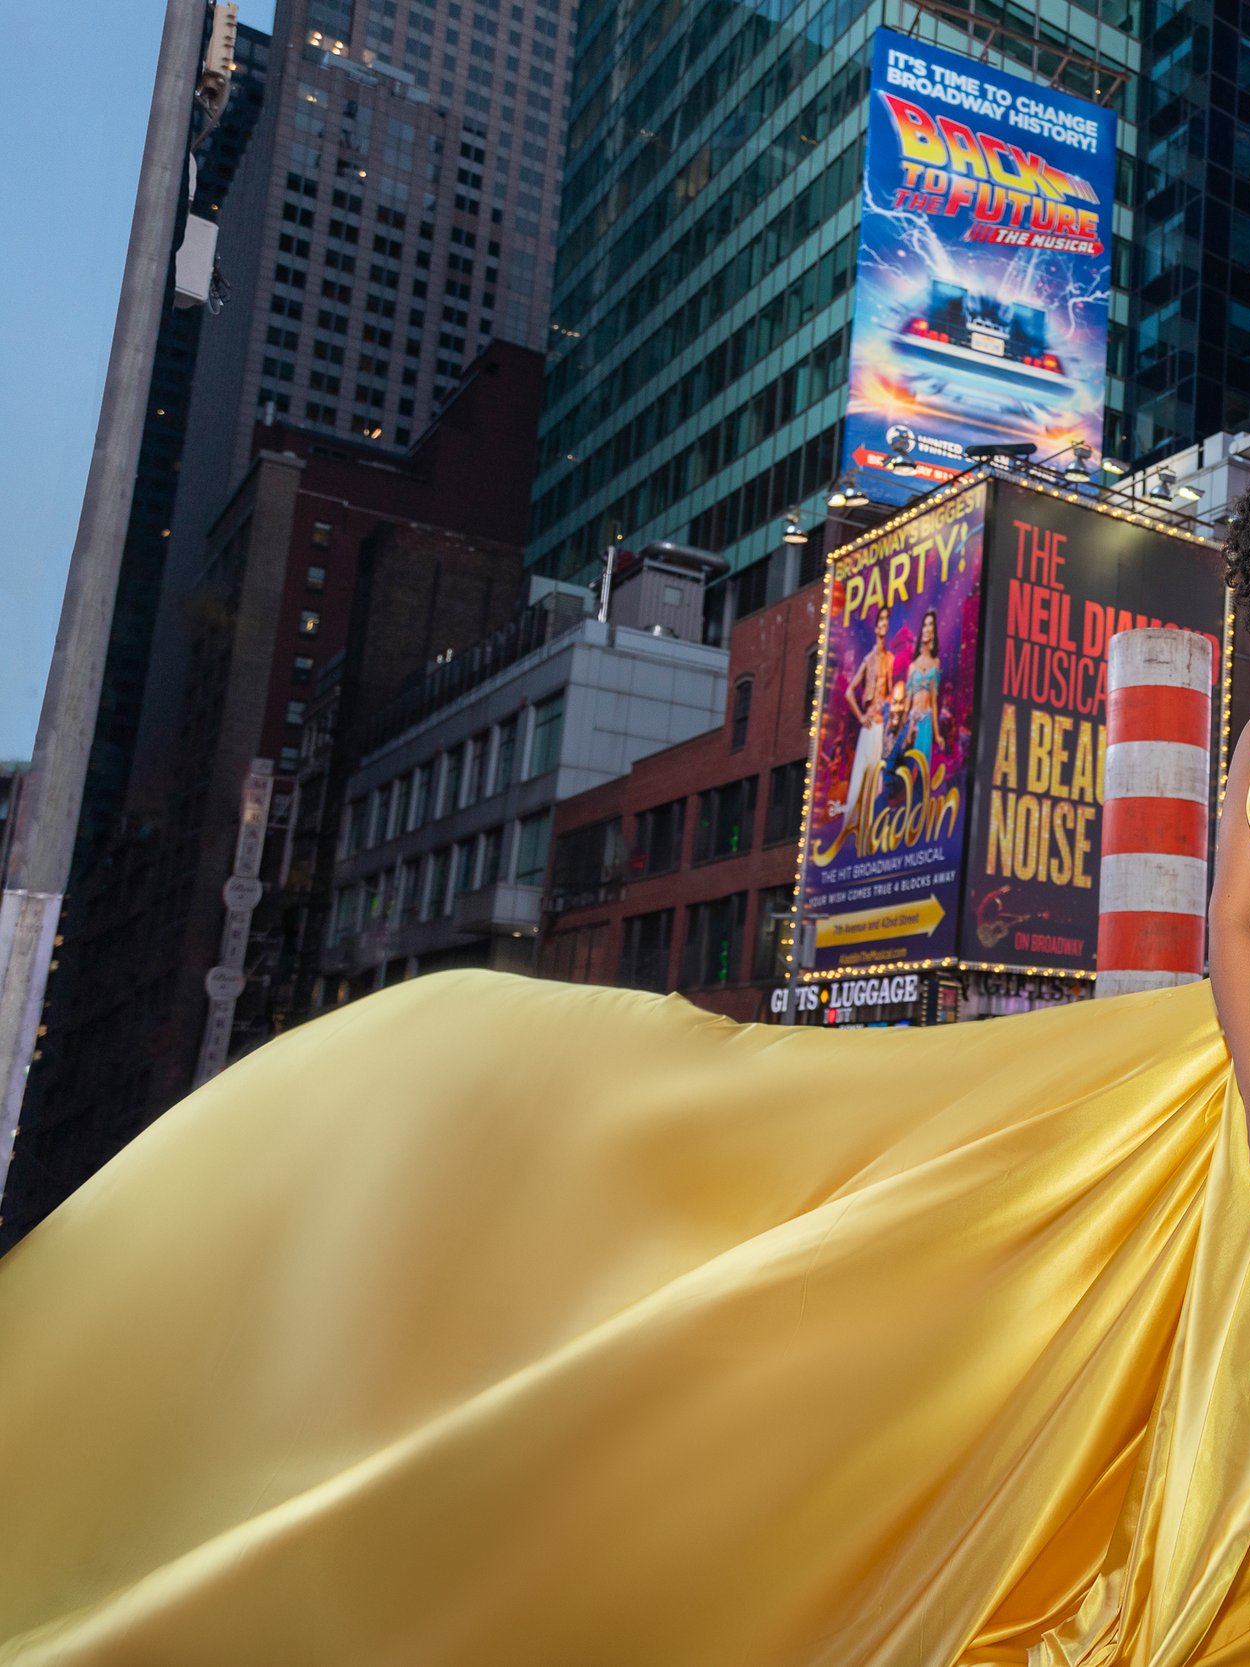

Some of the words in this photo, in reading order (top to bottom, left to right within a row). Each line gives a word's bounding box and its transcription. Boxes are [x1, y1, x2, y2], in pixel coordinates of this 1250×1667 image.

[887, 66, 1006, 121] BROADWAY
[1008, 110, 1097, 154] HISTORY!
[888, 49, 927, 77] IT'S
[931, 64, 980, 95] TIME
[983, 83, 1013, 107] TO
[1015, 96, 1098, 137] CHANGE
[876, 92, 1068, 203] BACK
[901, 160, 949, 195] TO
[896, 188, 945, 216] THE
[944, 173, 1100, 240] FUTURE
[995, 229, 1028, 245] THE
[1031, 234, 1097, 255] MUSICAL
[919, 488, 983, 538] BIGGEST
[843, 522, 969, 628] PARTY!
[1013, 519, 1068, 590] THE
[1007, 578, 1077, 652] NEIL
[992, 703, 1018, 789] A
[812, 749, 960, 868] Aladdin
[985, 788, 1097, 889] NOISE
[821, 869, 837, 884] THE
[838, 867, 852, 881] HIT
[853, 856, 904, 879] BROADWAY
[904, 848, 945, 868] MUSICAL
[828, 891, 846, 903] WISH
[848, 887, 872, 901] COMES
[873, 883, 892, 897] TRUE
[901, 876, 931, 891] BLOCKS
[933, 870, 956, 885] AWAY
[1014, 932, 1030, 951] ON
[1031, 933, 1085, 957] BROADWAY
[771, 984, 819, 1013] GITS
[829, 974, 919, 1008] LUGGAGE
